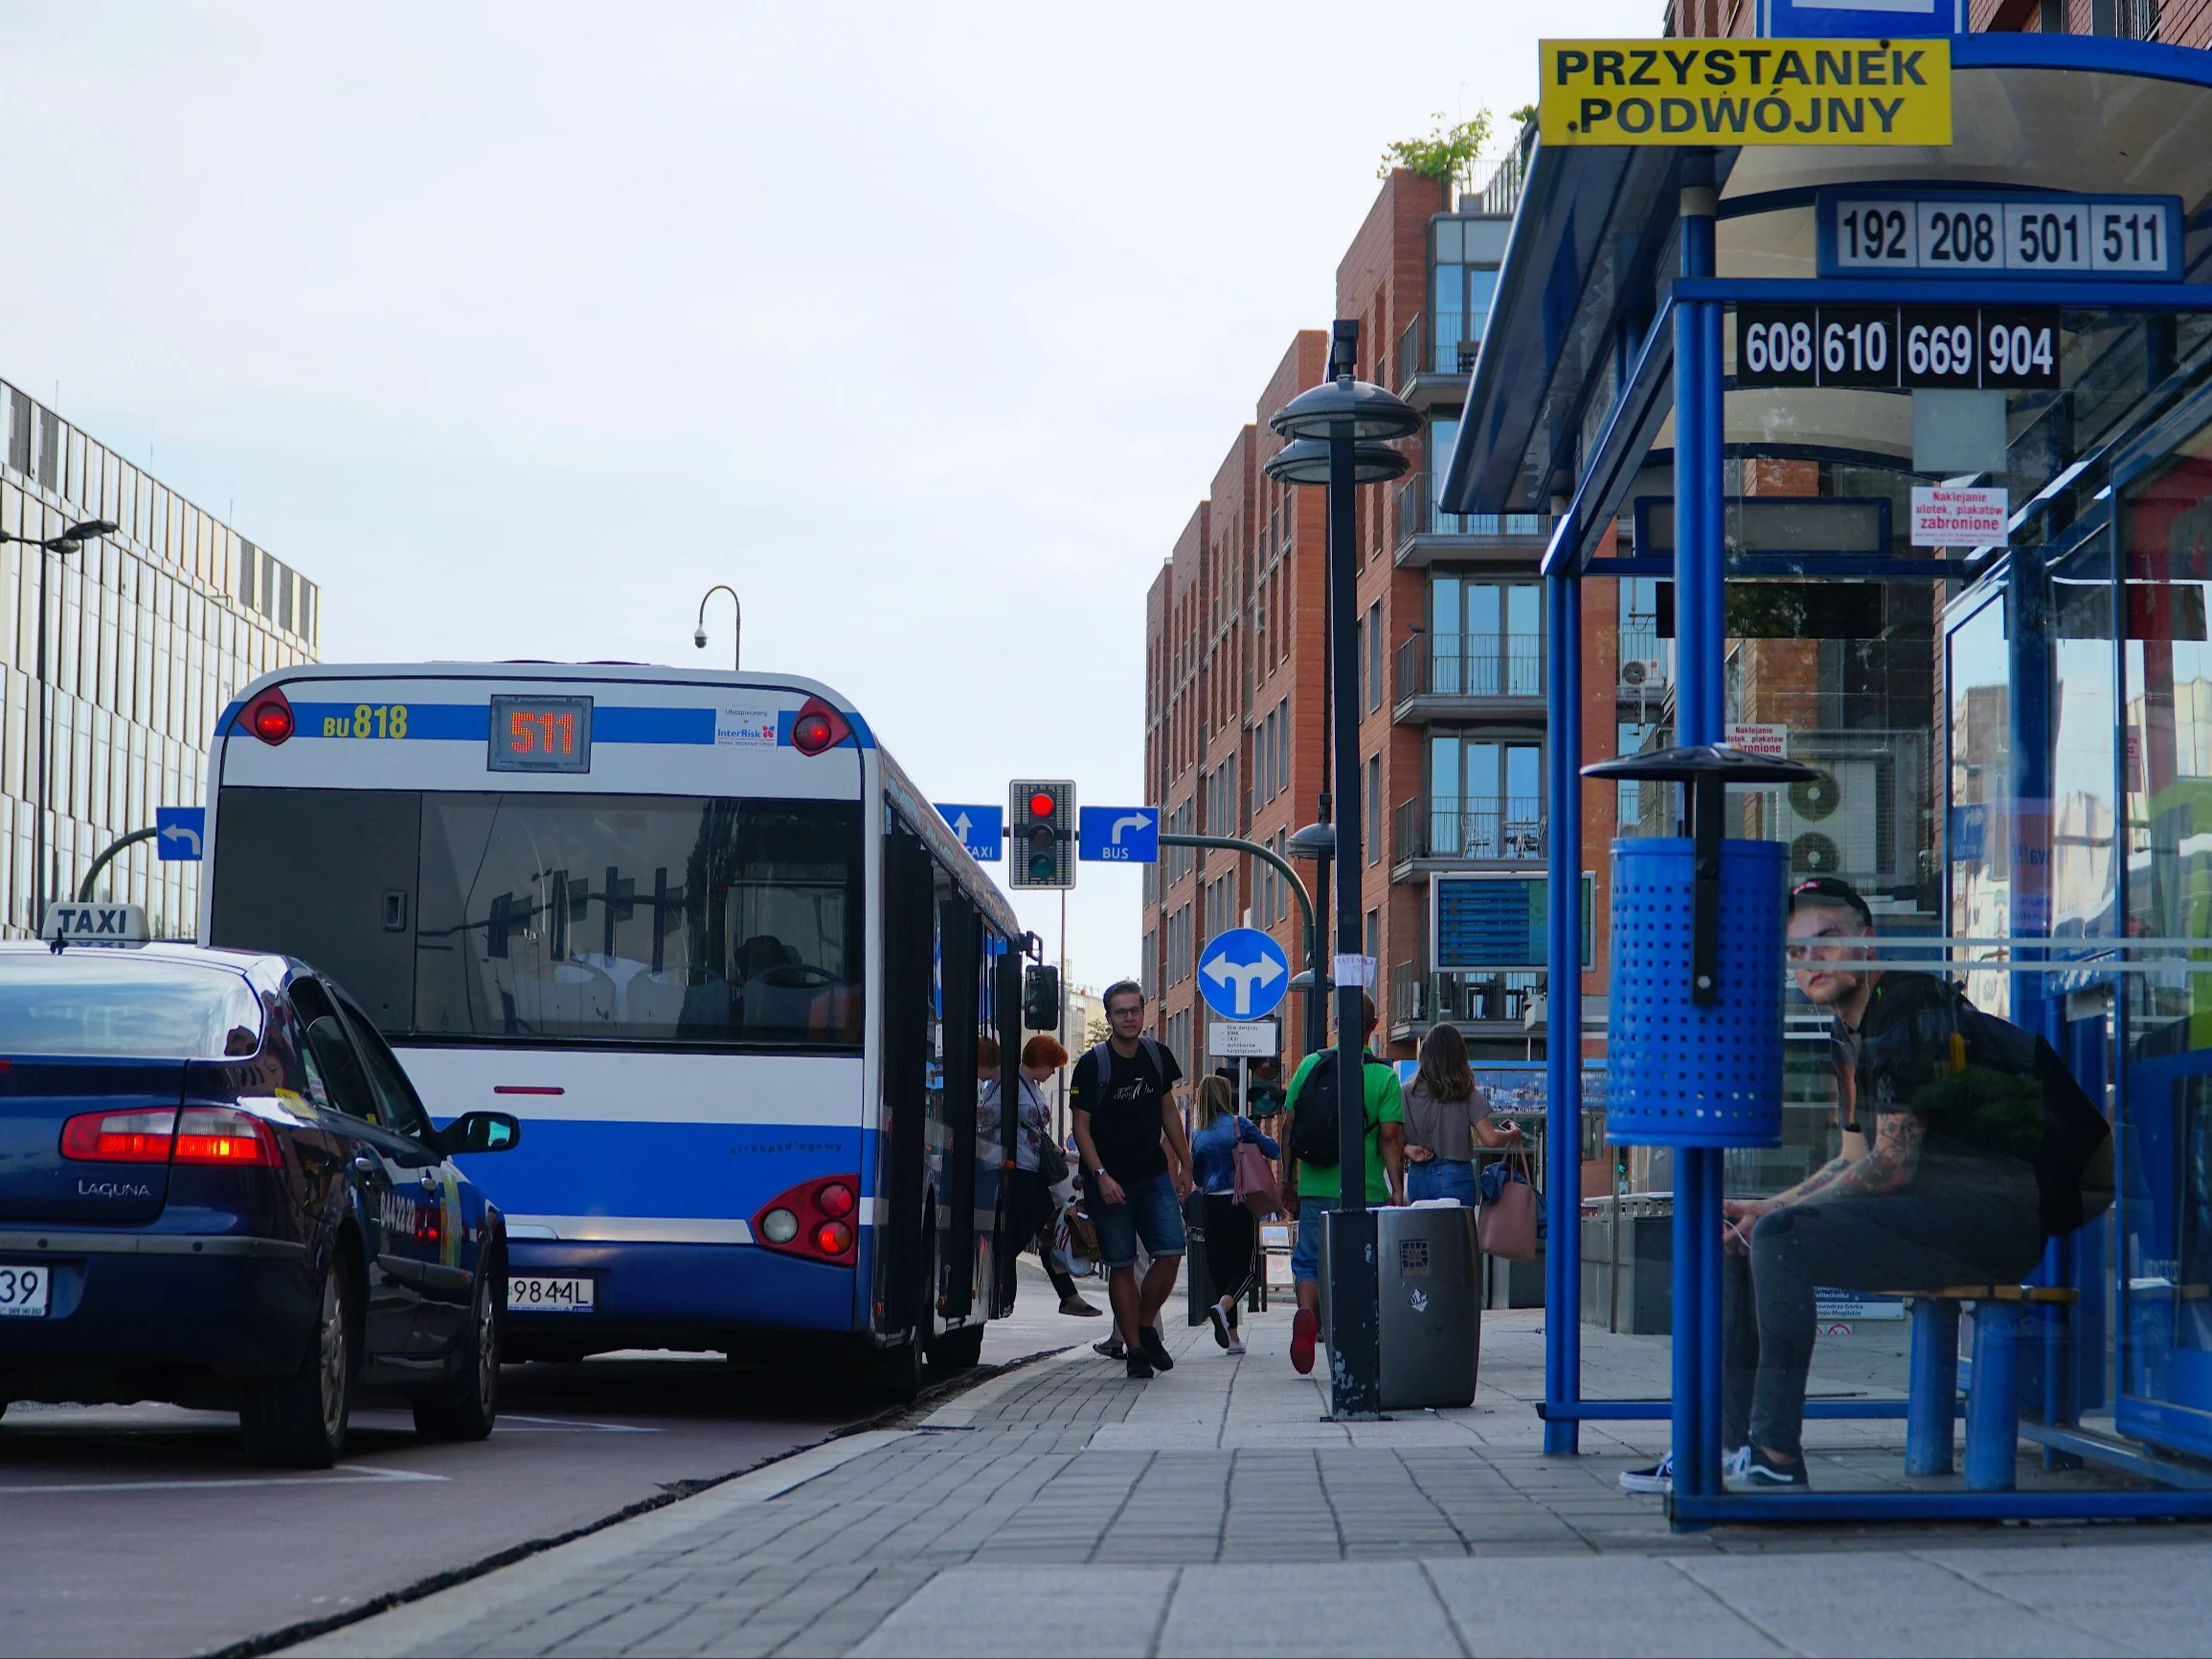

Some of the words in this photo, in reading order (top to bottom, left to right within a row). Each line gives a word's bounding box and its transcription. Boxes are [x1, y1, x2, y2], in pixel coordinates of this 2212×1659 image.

[1556, 50, 1927, 86] PRZYSTANEK
[1581, 88, 1905, 133] PODWÓJNY
[1842, 209, 1907, 259] 192
[1930, 212, 1995, 261] 208
[2020, 213, 2079, 263] 501
[2103, 213, 2159, 262] 511
[1746, 322, 1812, 372] 608
[1823, 322, 1886, 372] 610
[1907, 324, 1973, 374] 669
[1988, 325, 2054, 376] 904
[1932, 491, 1987, 503] Naklejanie
[1916, 504, 1952, 515] ulotek,
[1956, 504, 2003, 516] plakatów
[1921, 516, 1999, 530] zabronione
[510, 711, 574, 753] 511
[717, 728, 761, 738] InterRisk
[1735, 726, 1773, 734] Naklejanie
[1103, 847, 1129, 859] BUS
[57, 909, 126, 933] TAXI
[78, 1178, 151, 1198] LAGUNA
